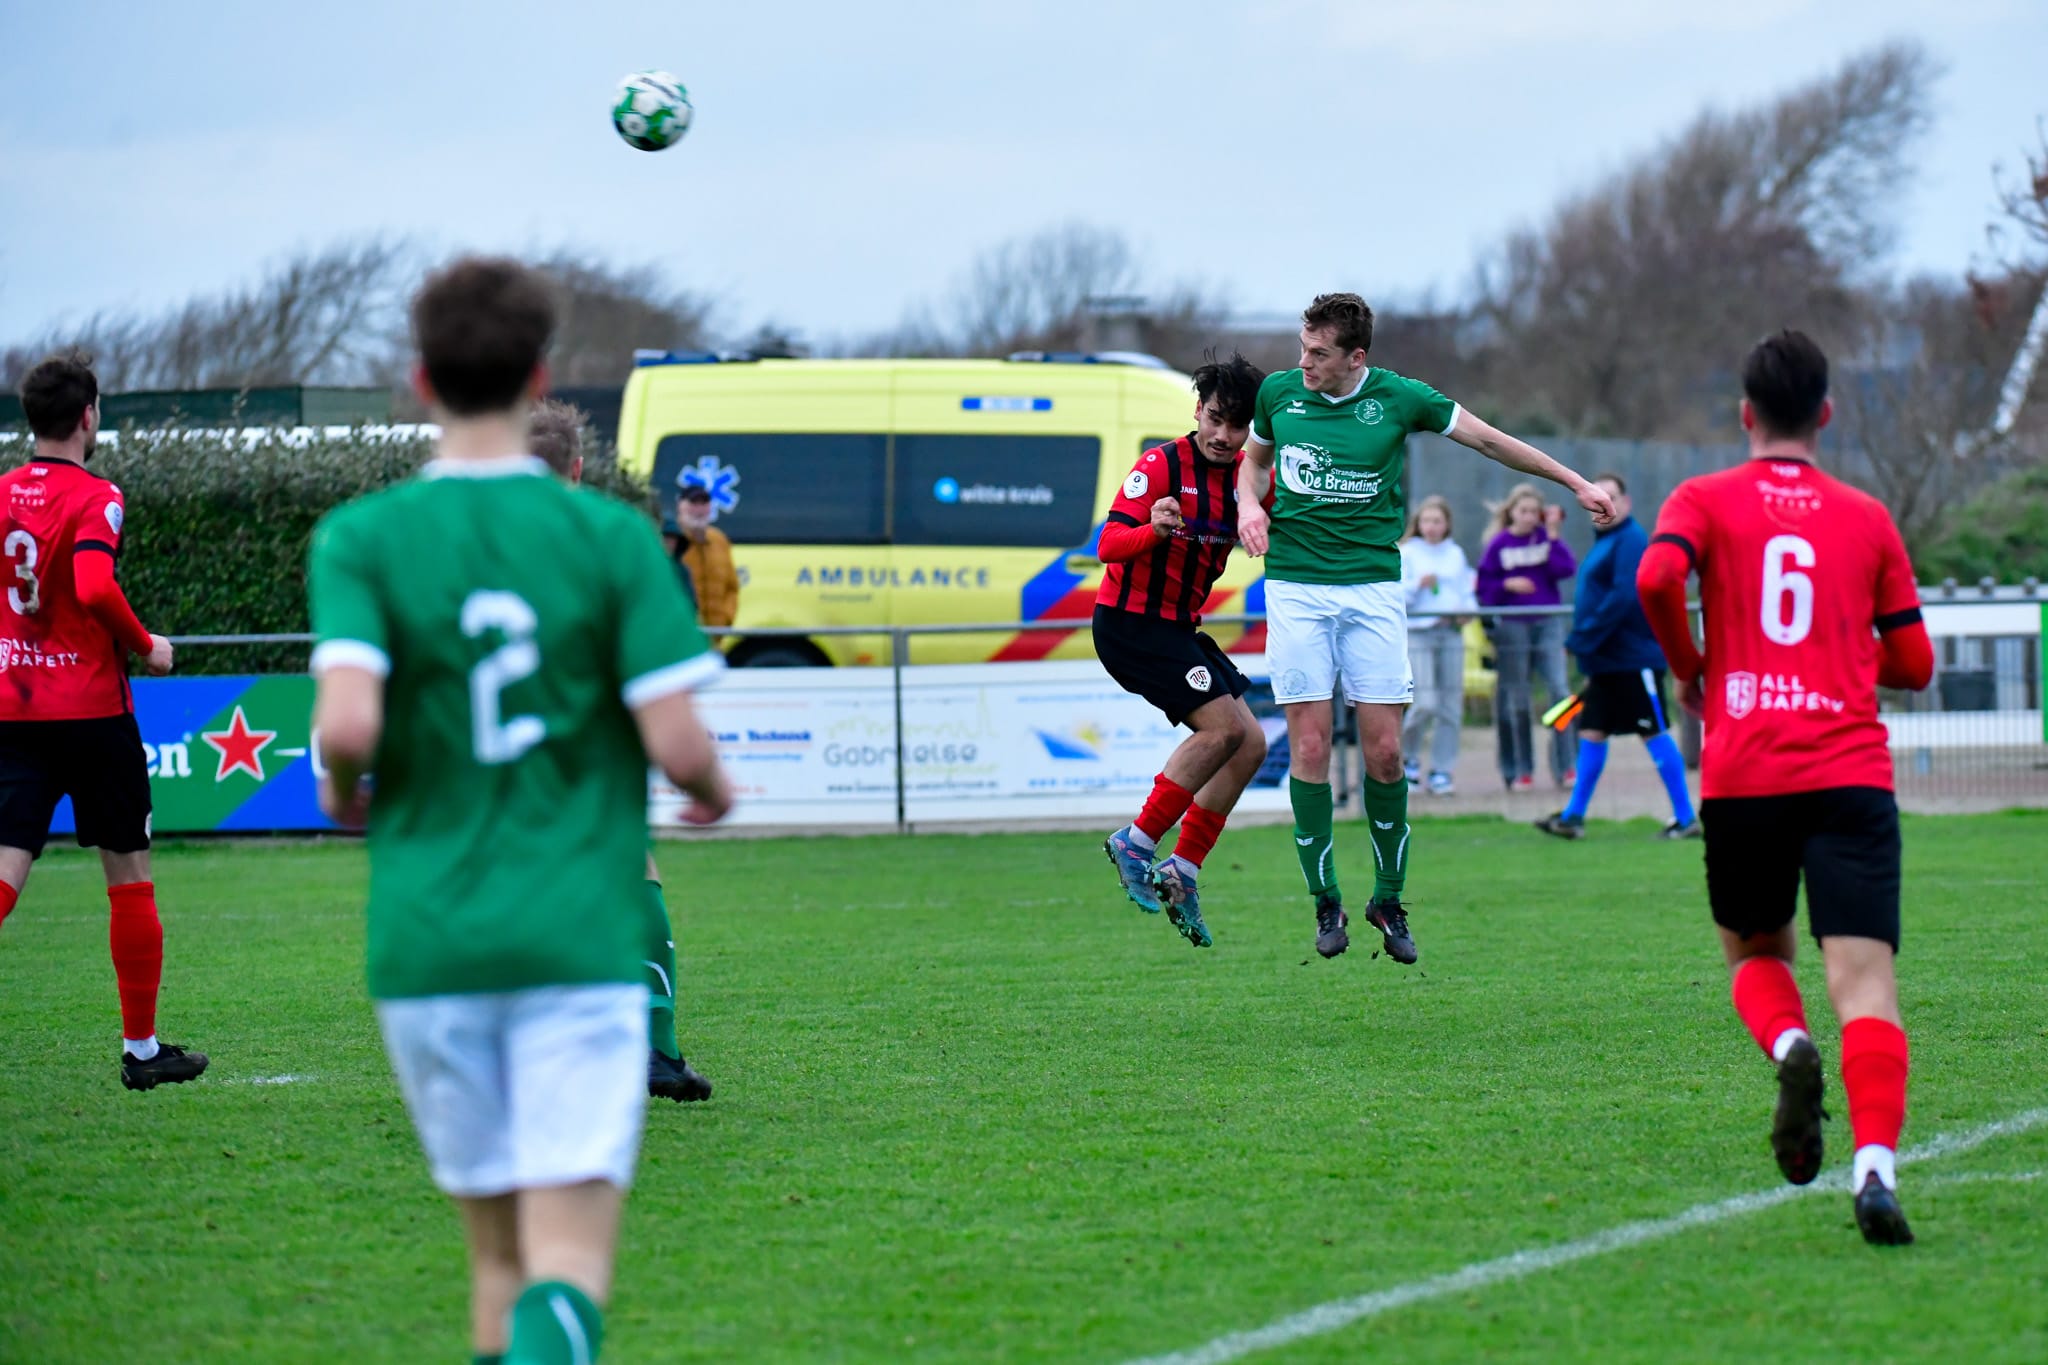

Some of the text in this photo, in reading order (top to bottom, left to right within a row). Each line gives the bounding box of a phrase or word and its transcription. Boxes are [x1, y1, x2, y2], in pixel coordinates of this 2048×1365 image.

[1180, 485, 1198, 495] JAKO
[4, 529, 40, 616] 3
[797, 566, 990, 587] AMBULANCE
[1760, 534, 1816, 646] 6
[12, 638, 42, 653] ALL
[11, 652, 78, 667] SAFETY
[460, 589, 547, 764] 2
[1760, 673, 1805, 692] ALL
